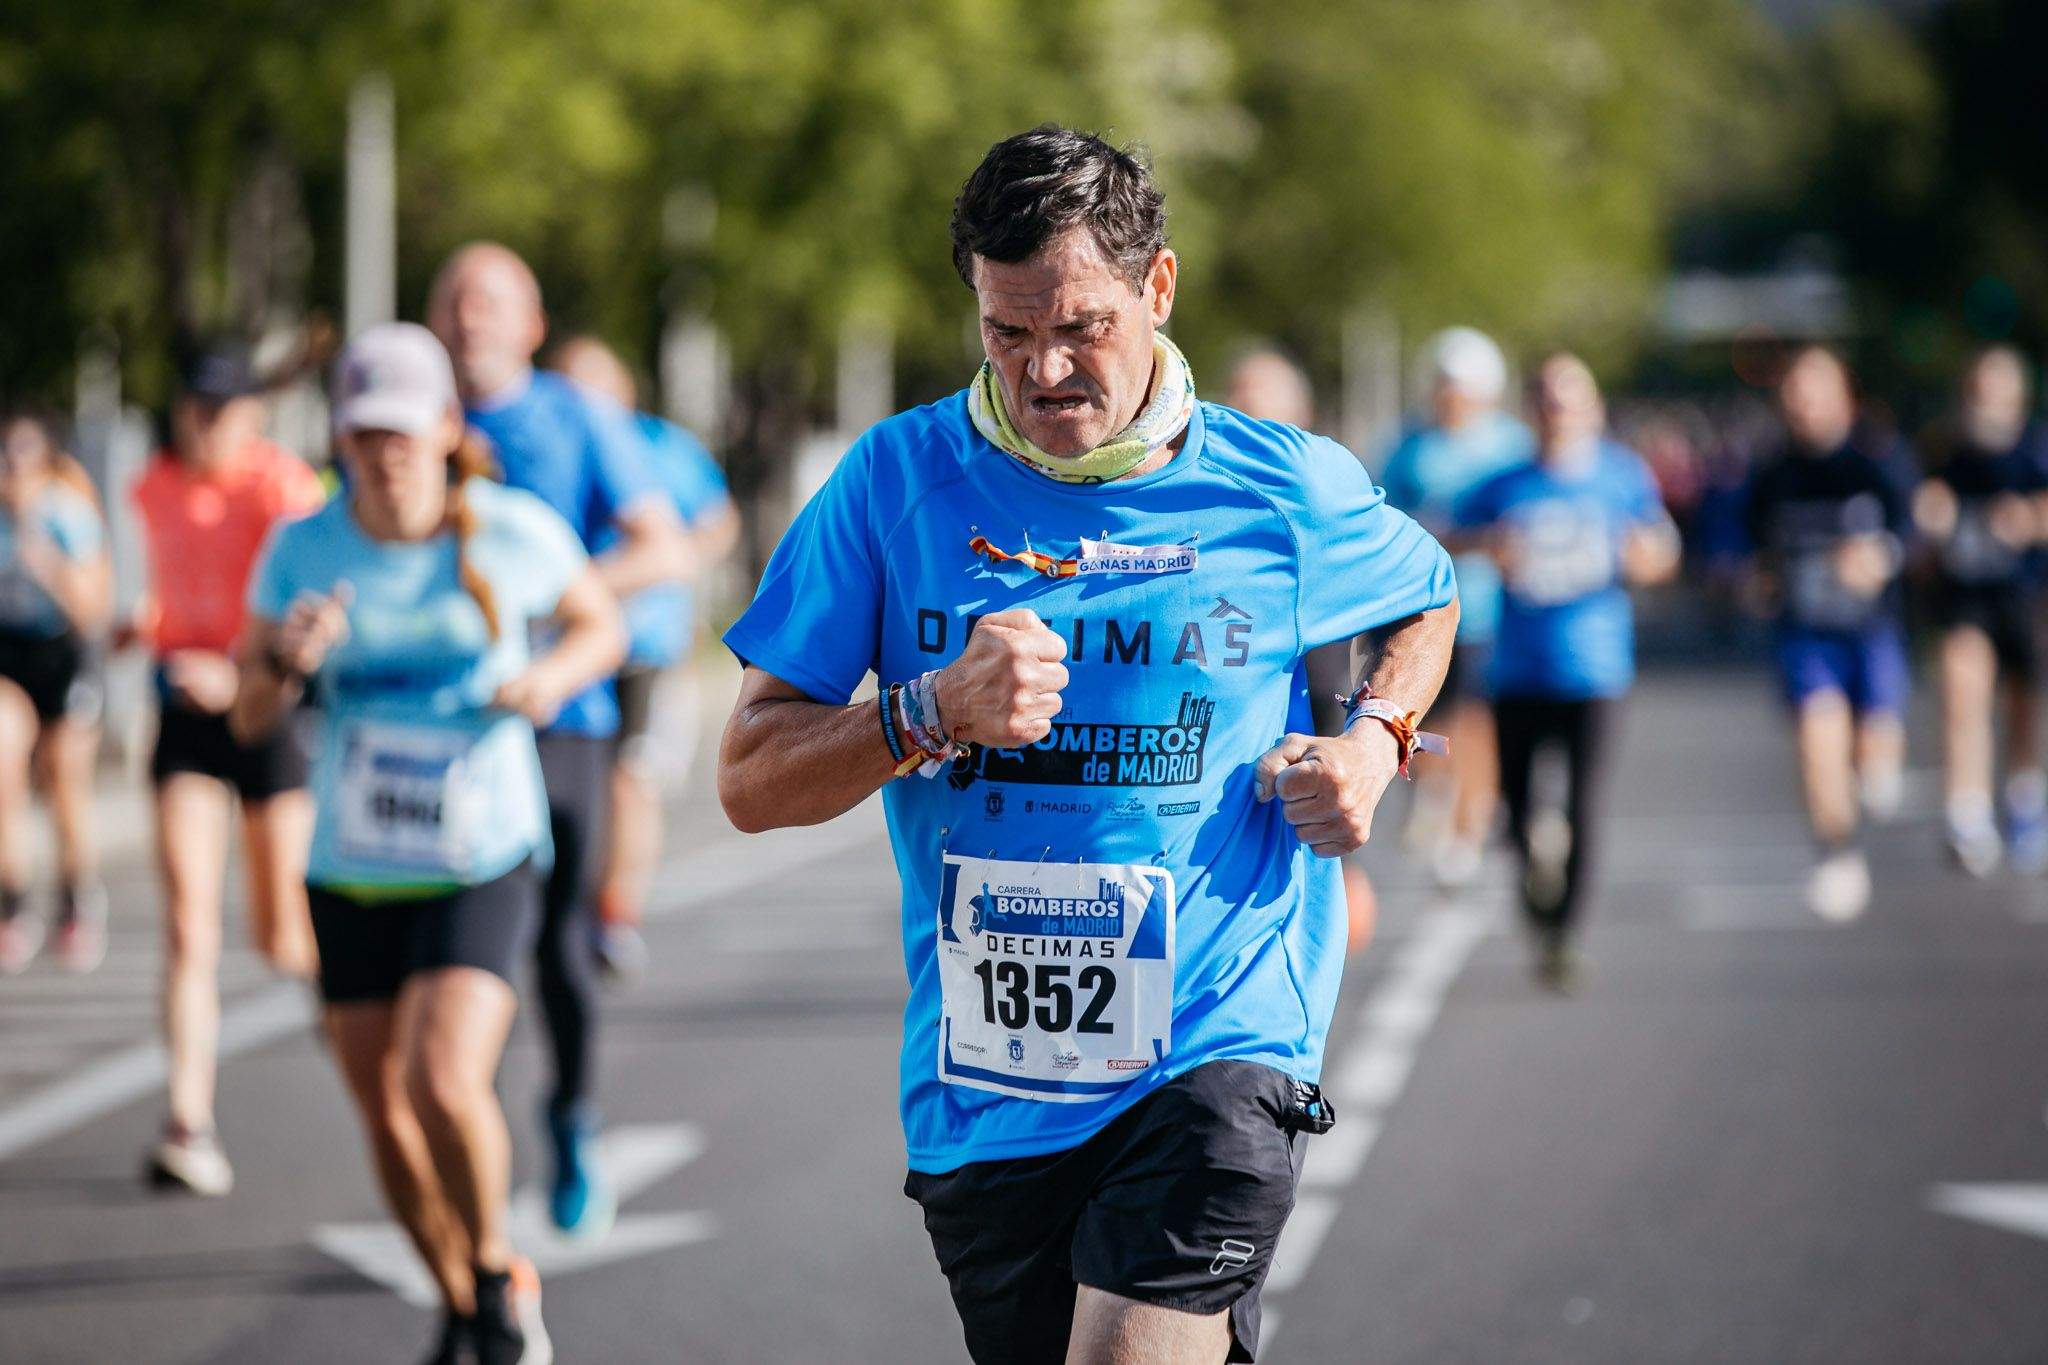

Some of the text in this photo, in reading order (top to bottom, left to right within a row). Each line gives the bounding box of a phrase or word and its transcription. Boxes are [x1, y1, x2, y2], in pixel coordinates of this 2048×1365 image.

[1079, 555, 1191, 572] GANAS MADRID
[917, 608, 1254, 668] DIMAS
[1033, 725, 1203, 754] OMBEROS
[1082, 752, 1199, 784] de MADRID
[1040, 802, 1092, 815] MADRID
[997, 885, 1042, 896] CARRERA
[996, 896, 1119, 918] BOMBEROS
[1041, 917, 1119, 936] de MADRID
[986, 934, 1115, 959] DECIMAS
[973, 958, 1117, 1035] 1352
